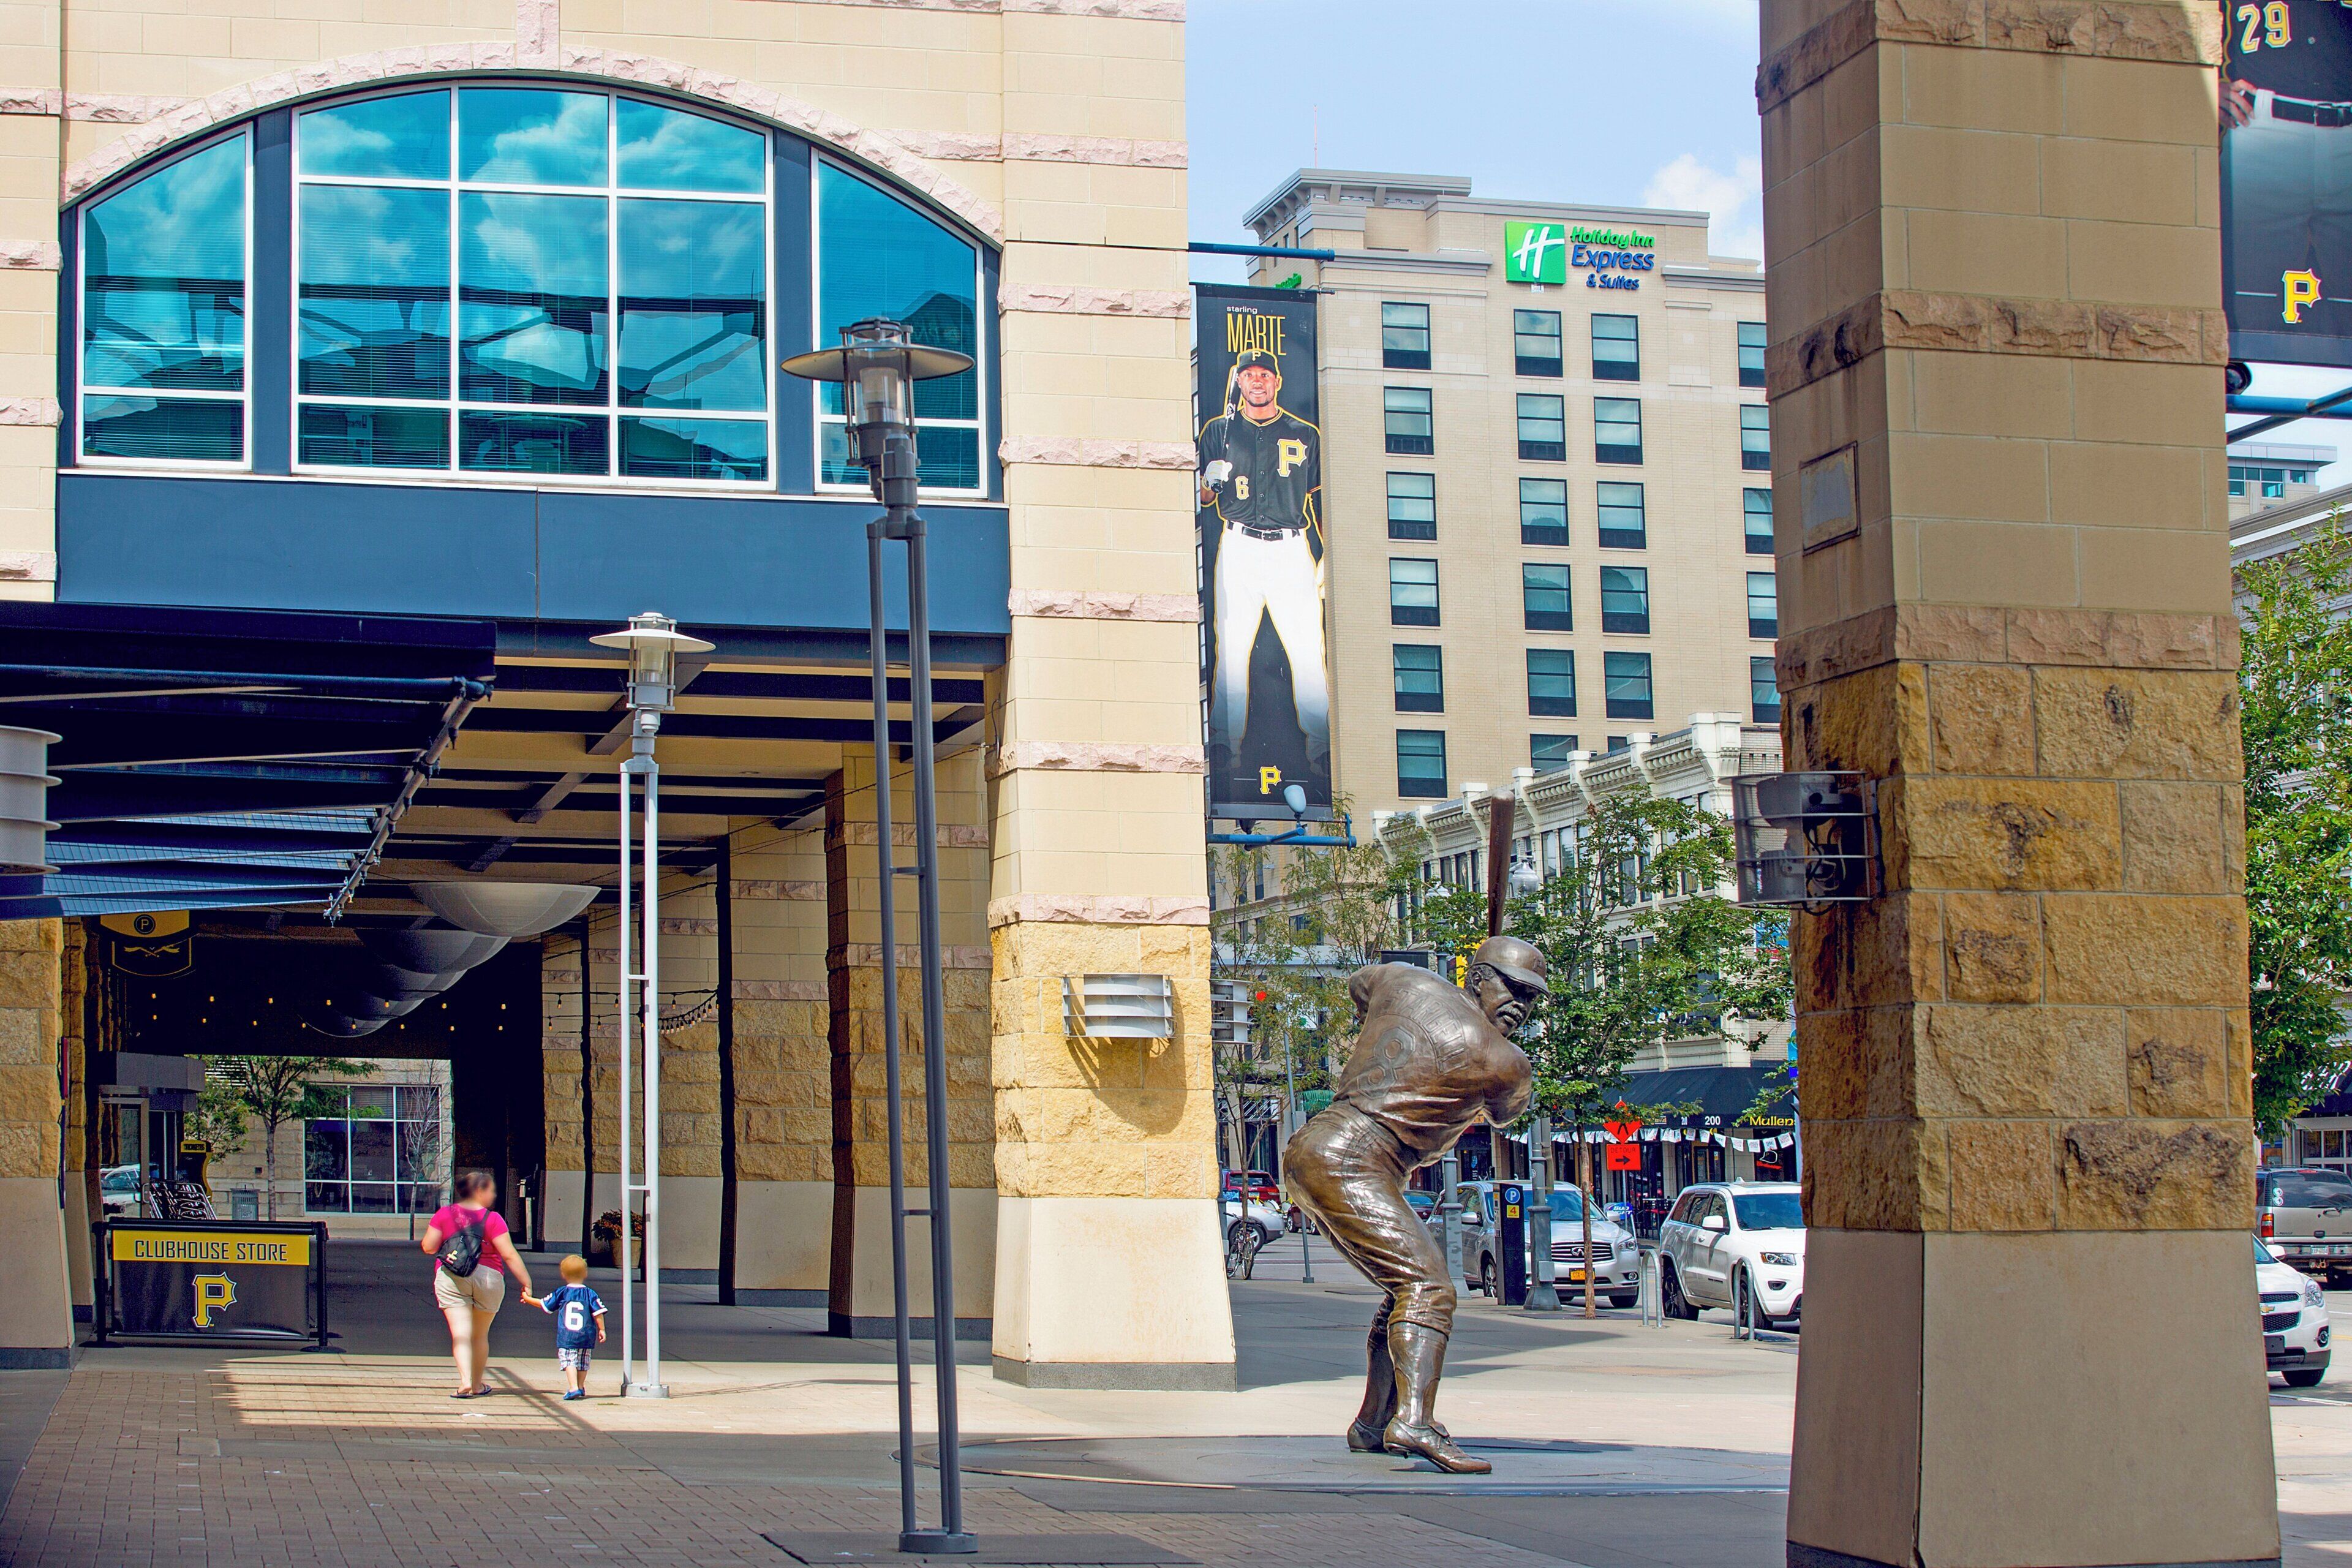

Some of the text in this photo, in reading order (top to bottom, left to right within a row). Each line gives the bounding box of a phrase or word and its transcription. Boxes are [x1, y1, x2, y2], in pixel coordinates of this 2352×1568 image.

[2237, 1, 2291, 54] 29
[1570, 227, 1654, 249] Holiday Inn
[1572, 244, 1655, 273] Express
[1586, 273, 1640, 290] & Suites
[2282, 268, 2321, 323] P
[1227, 306, 1257, 315] starling
[1227, 314, 1287, 356] MARTE
[1252, 350, 1261, 361] P
[1277, 439, 1308, 477] P
[1235, 476, 1250, 500] 6
[1259, 766, 1282, 794] P
[1705, 1116, 1721, 1125] 200
[1750, 1116, 1796, 1126] Mullen
[1510, 1191, 1517, 1200] P
[134, 1239, 288, 1262] CLUBHOUSE STORE
[192, 1272, 237, 1328] P
[565, 1301, 584, 1331] 6
